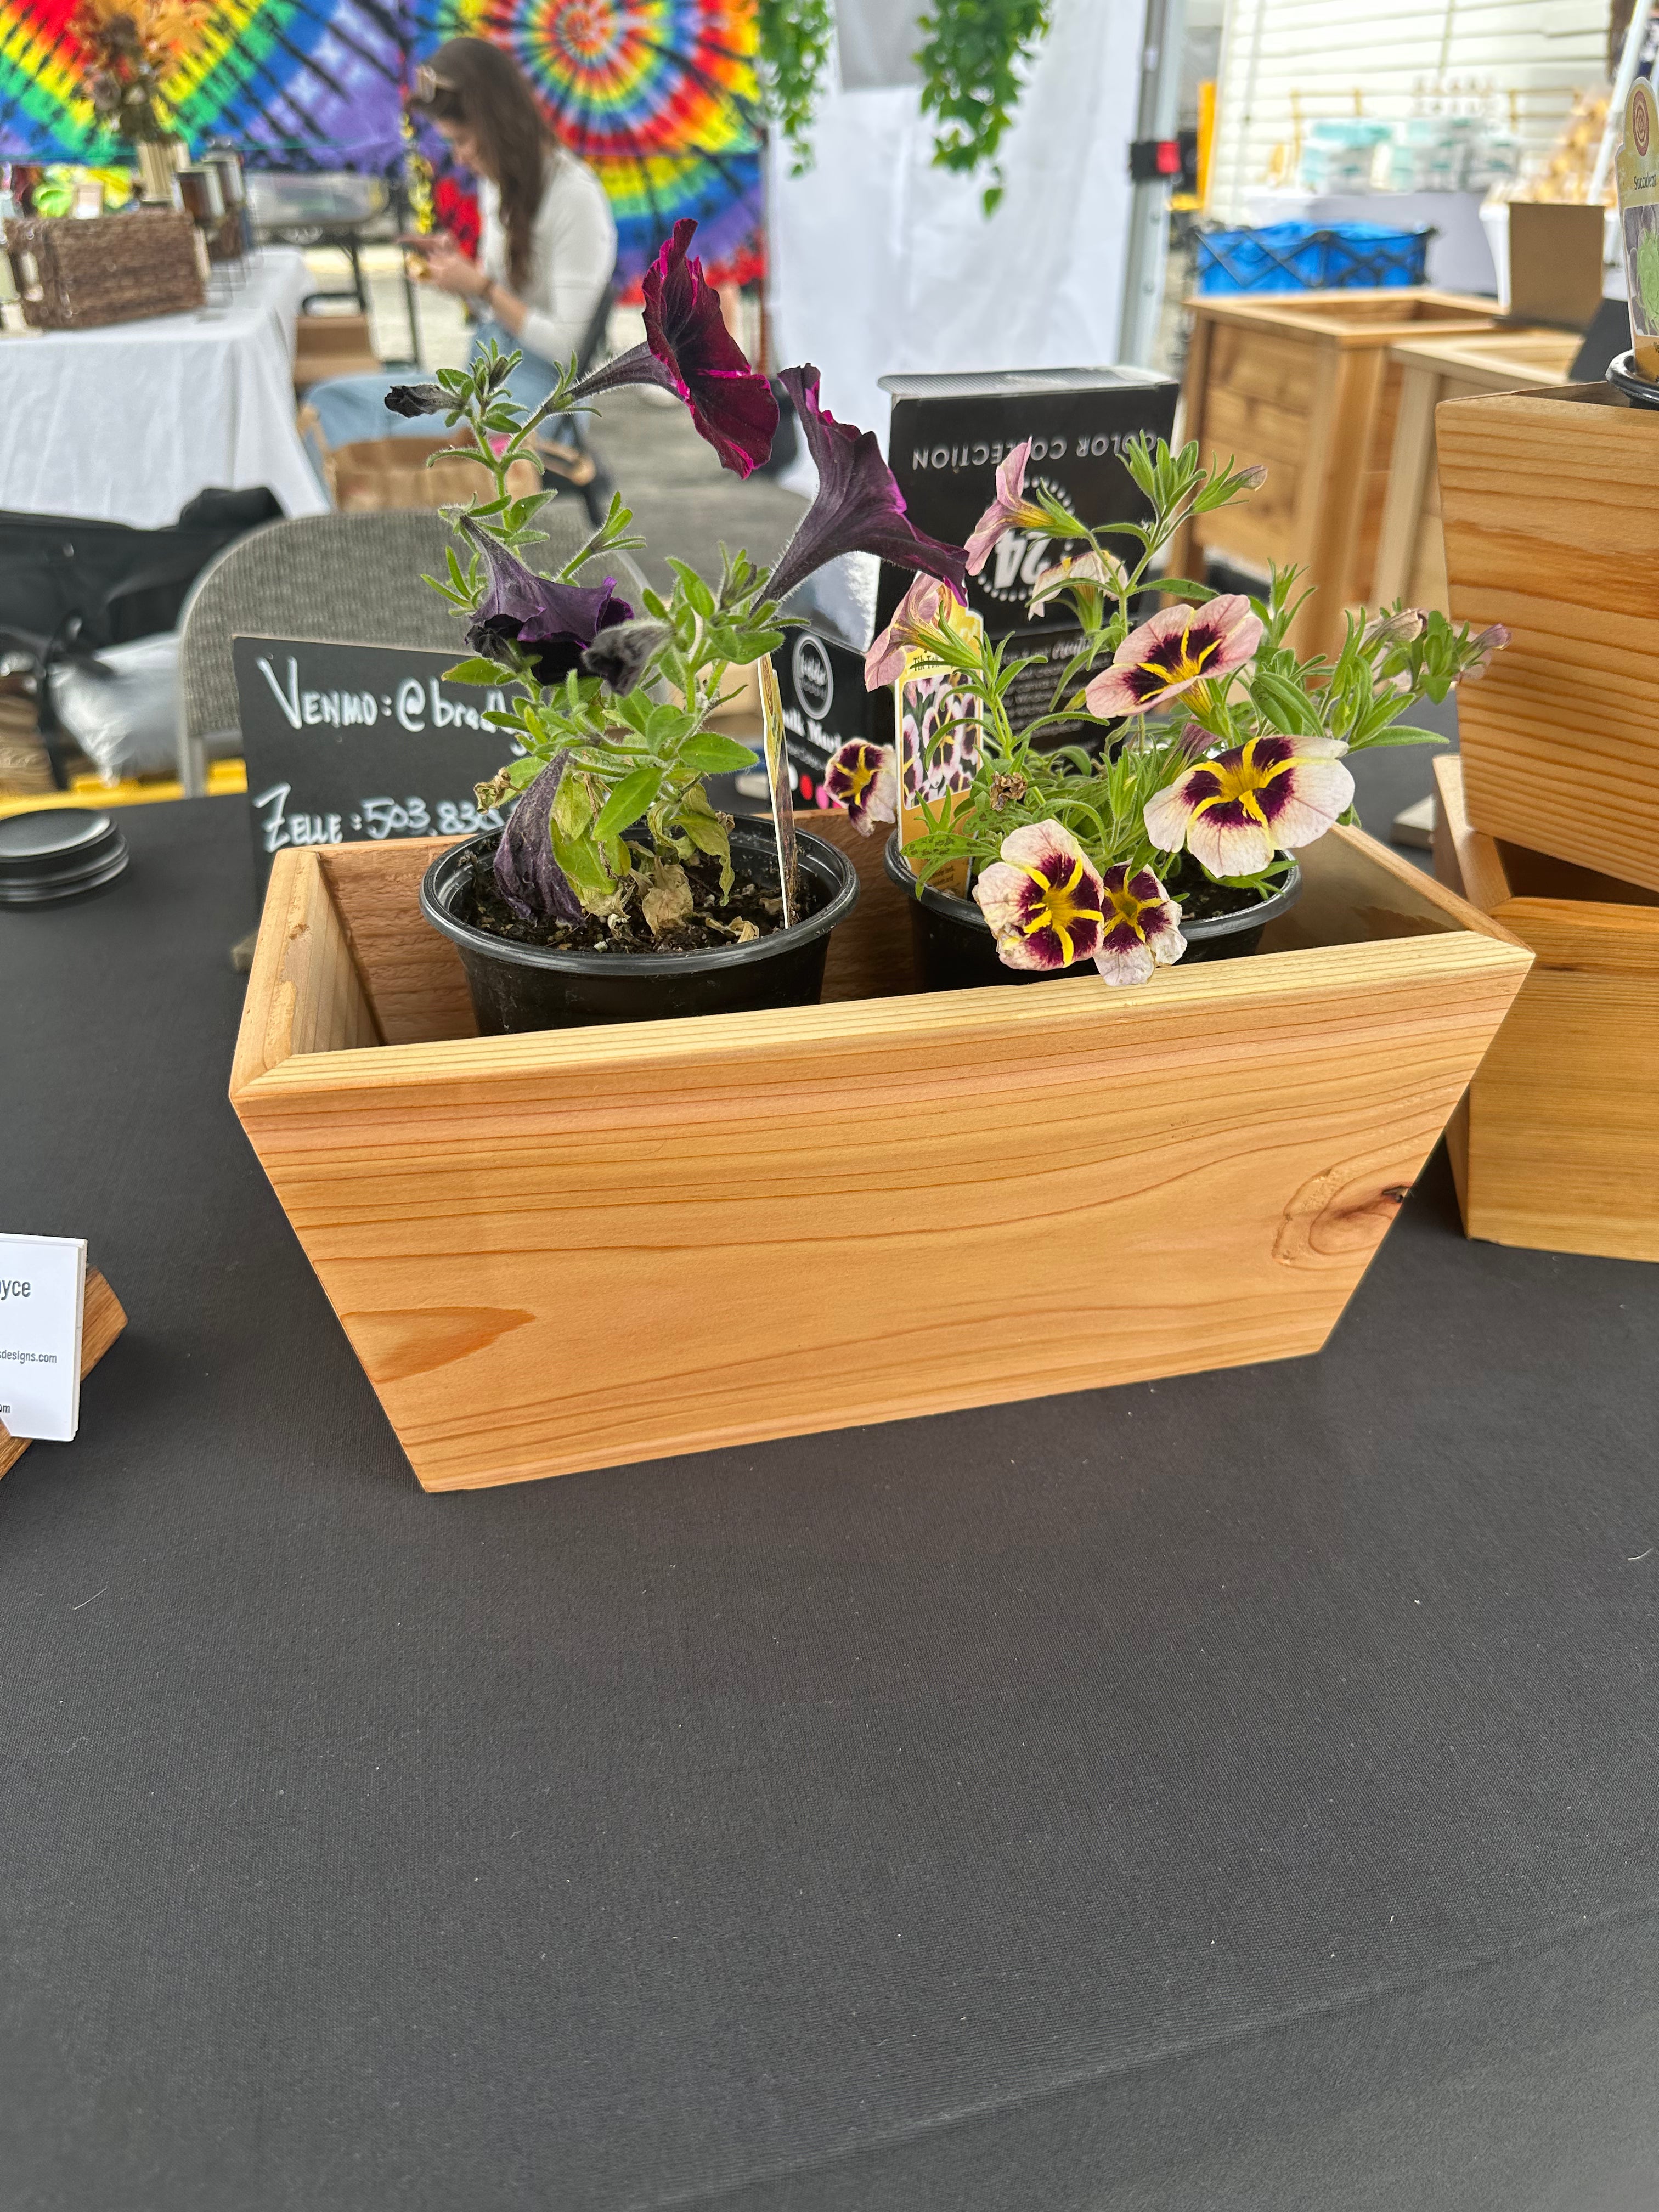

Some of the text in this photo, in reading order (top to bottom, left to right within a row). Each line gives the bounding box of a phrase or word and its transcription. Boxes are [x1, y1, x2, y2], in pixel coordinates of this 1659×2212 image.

[1634, 172, 1657, 190] Succulent
[912, 430, 1158, 471] COLOR COLECTION
[994, 529, 1052, 589] 24
[0, 1280, 31, 1301] yce
